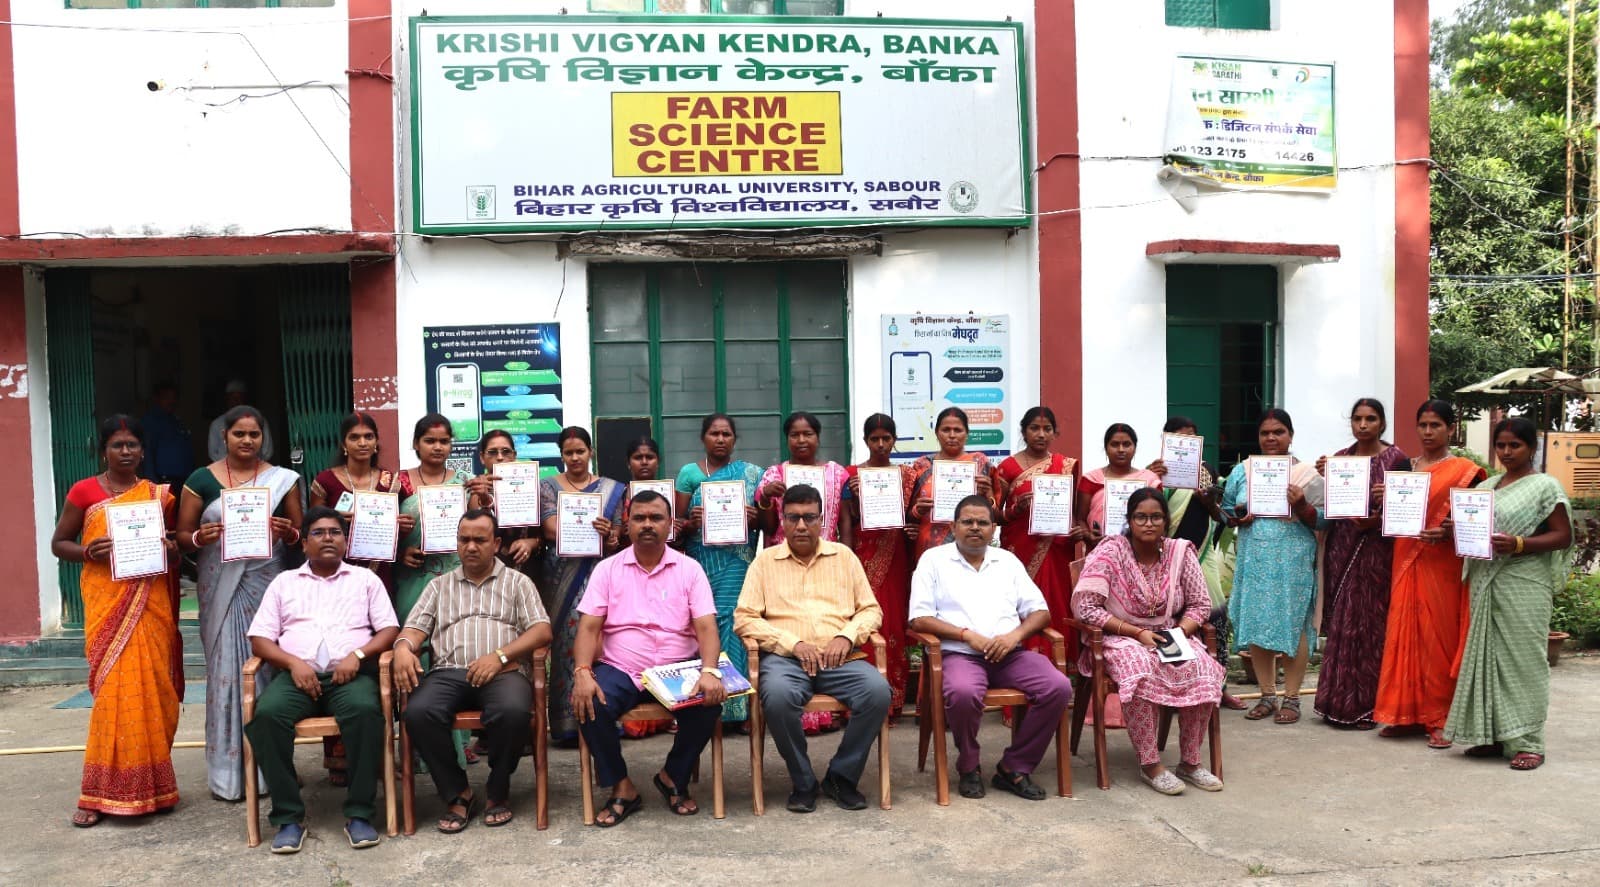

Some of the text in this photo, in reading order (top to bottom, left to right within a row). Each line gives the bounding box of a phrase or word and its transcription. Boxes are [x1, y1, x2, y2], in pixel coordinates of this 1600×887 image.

[436, 33, 999, 57] KRISHI VIGYAN KENDRA, BANKA
[442, 57, 997, 90] कृषि विज्ञान केन्द्र, बाँका
[1211, 61, 1242, 71] KISAN
[667, 96, 787, 119] FARM
[628, 122, 826, 146] SCIENCE
[1295, 123, 1317, 135] सेवा
[637, 149, 819, 173] CENTRE
[1190, 145, 1212, 156] 123
[1217, 146, 1246, 159] 2175
[513, 180, 941, 196] BIHAR AGRICULTURAL UNIVERSITY, SABOUR
[514, 199, 595, 216] बिहार
[601, 197, 662, 219] कृषि
[952, 326, 979, 343] मेघदूत
